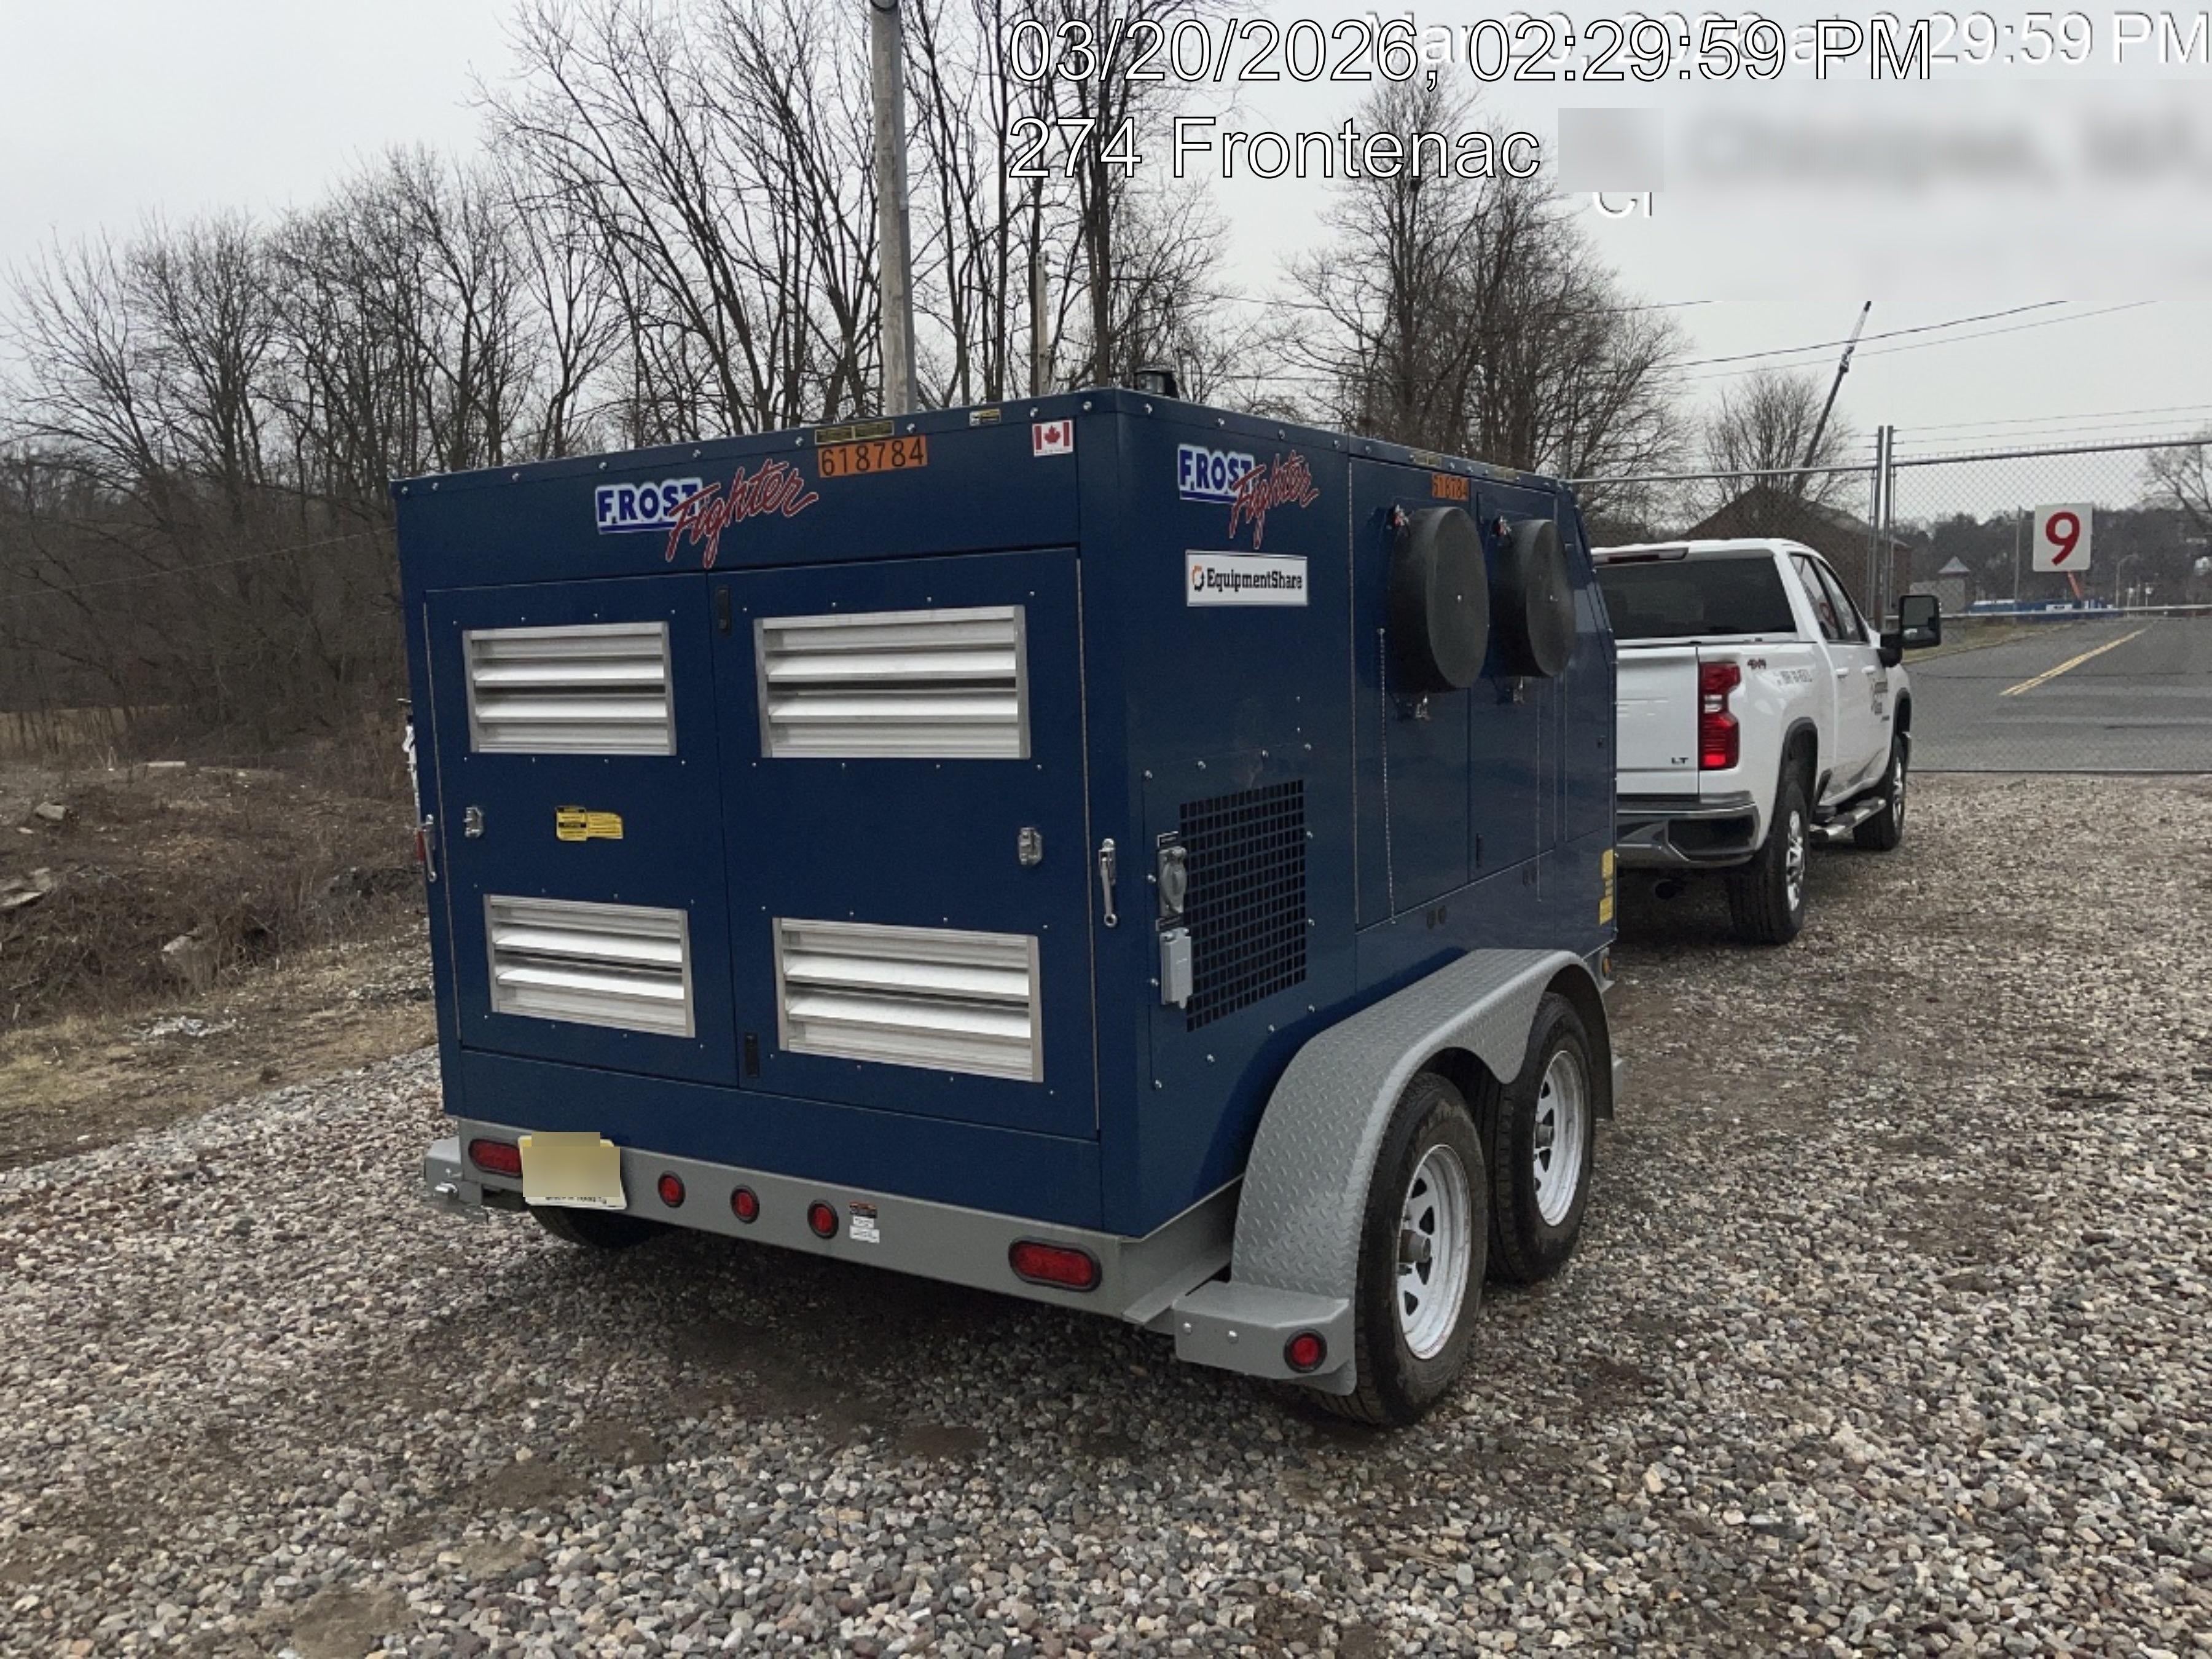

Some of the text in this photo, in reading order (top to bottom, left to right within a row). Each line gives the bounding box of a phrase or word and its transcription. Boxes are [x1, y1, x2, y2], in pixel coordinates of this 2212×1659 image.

[821, 437, 924, 476] 618784
[665, 459, 819, 570] Fighter
[2045, 511, 2081, 566] 9
[1206, 567, 1303, 593] EquipmentShare
[1671, 756, 1689, 765] LT
